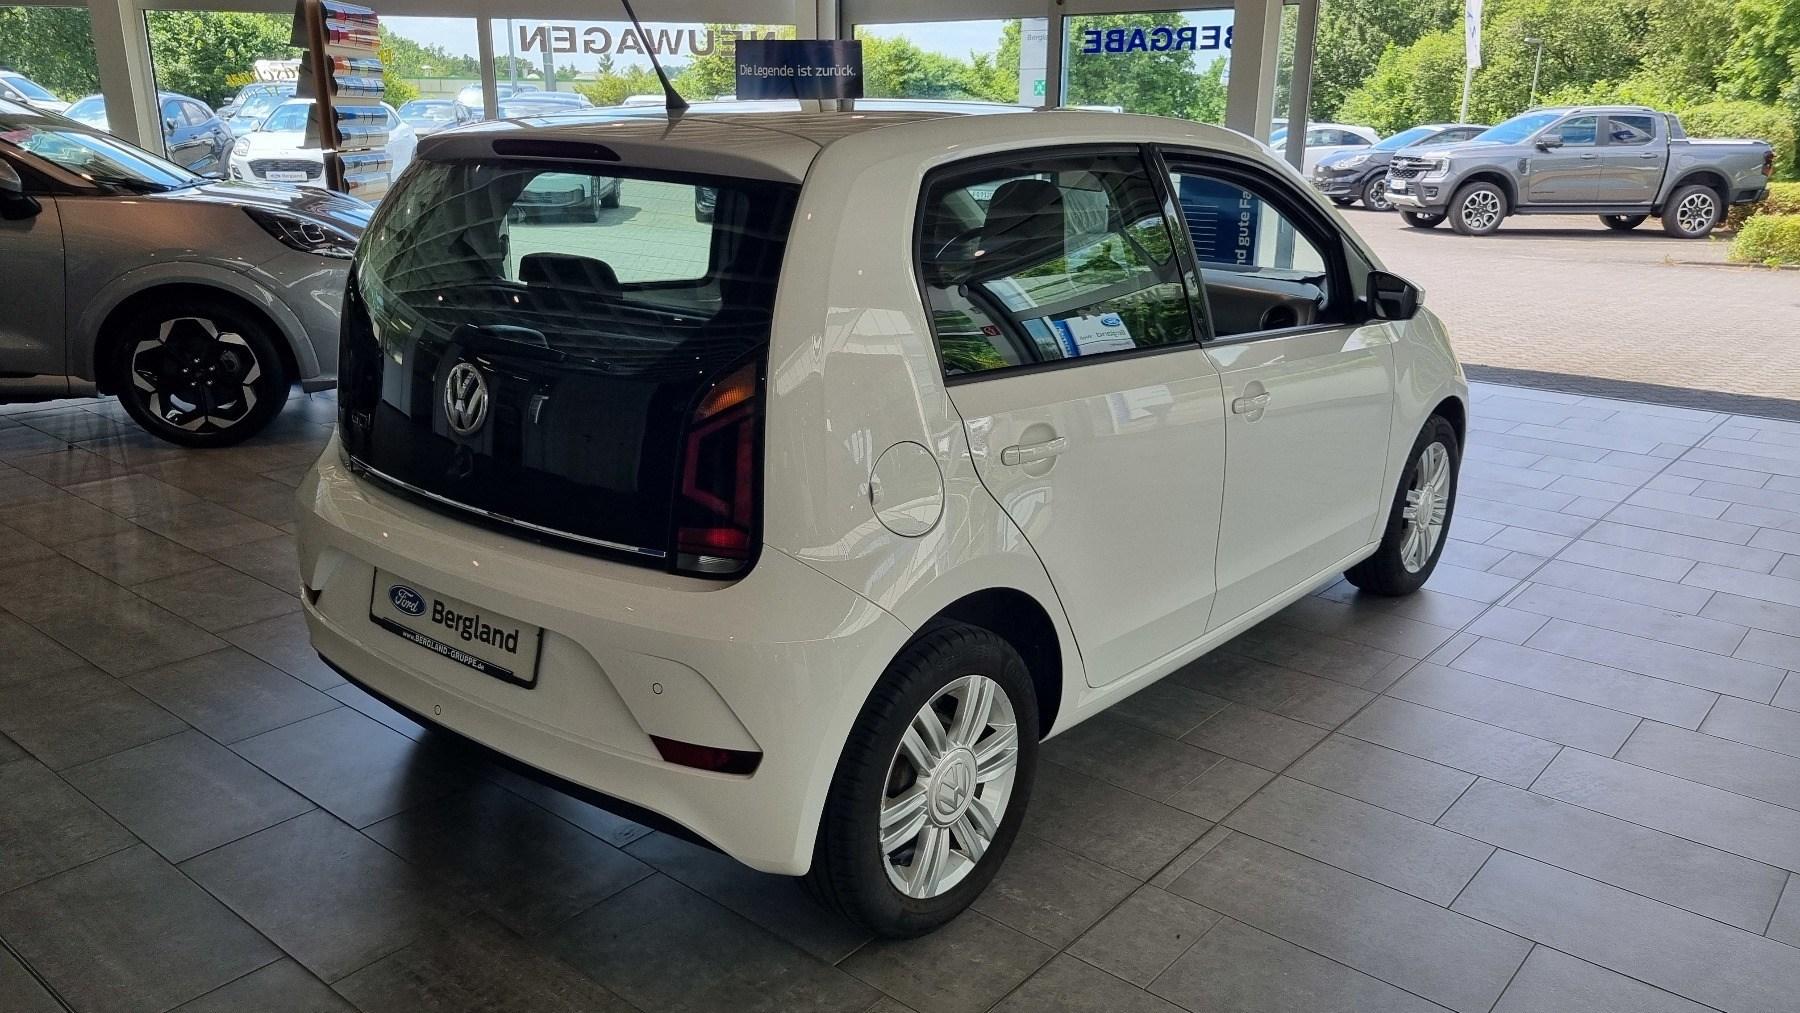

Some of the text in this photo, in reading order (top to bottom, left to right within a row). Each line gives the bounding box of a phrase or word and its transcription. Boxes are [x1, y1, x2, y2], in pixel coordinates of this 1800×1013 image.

[740, 64, 857, 78] Die Legende ist zurück.
[1237, 211, 1250, 247] gute
[395, 587, 519, 654] Ford Bergland
[402, 632, 485, 670] www.BERGLAND-GRUPPE.de
